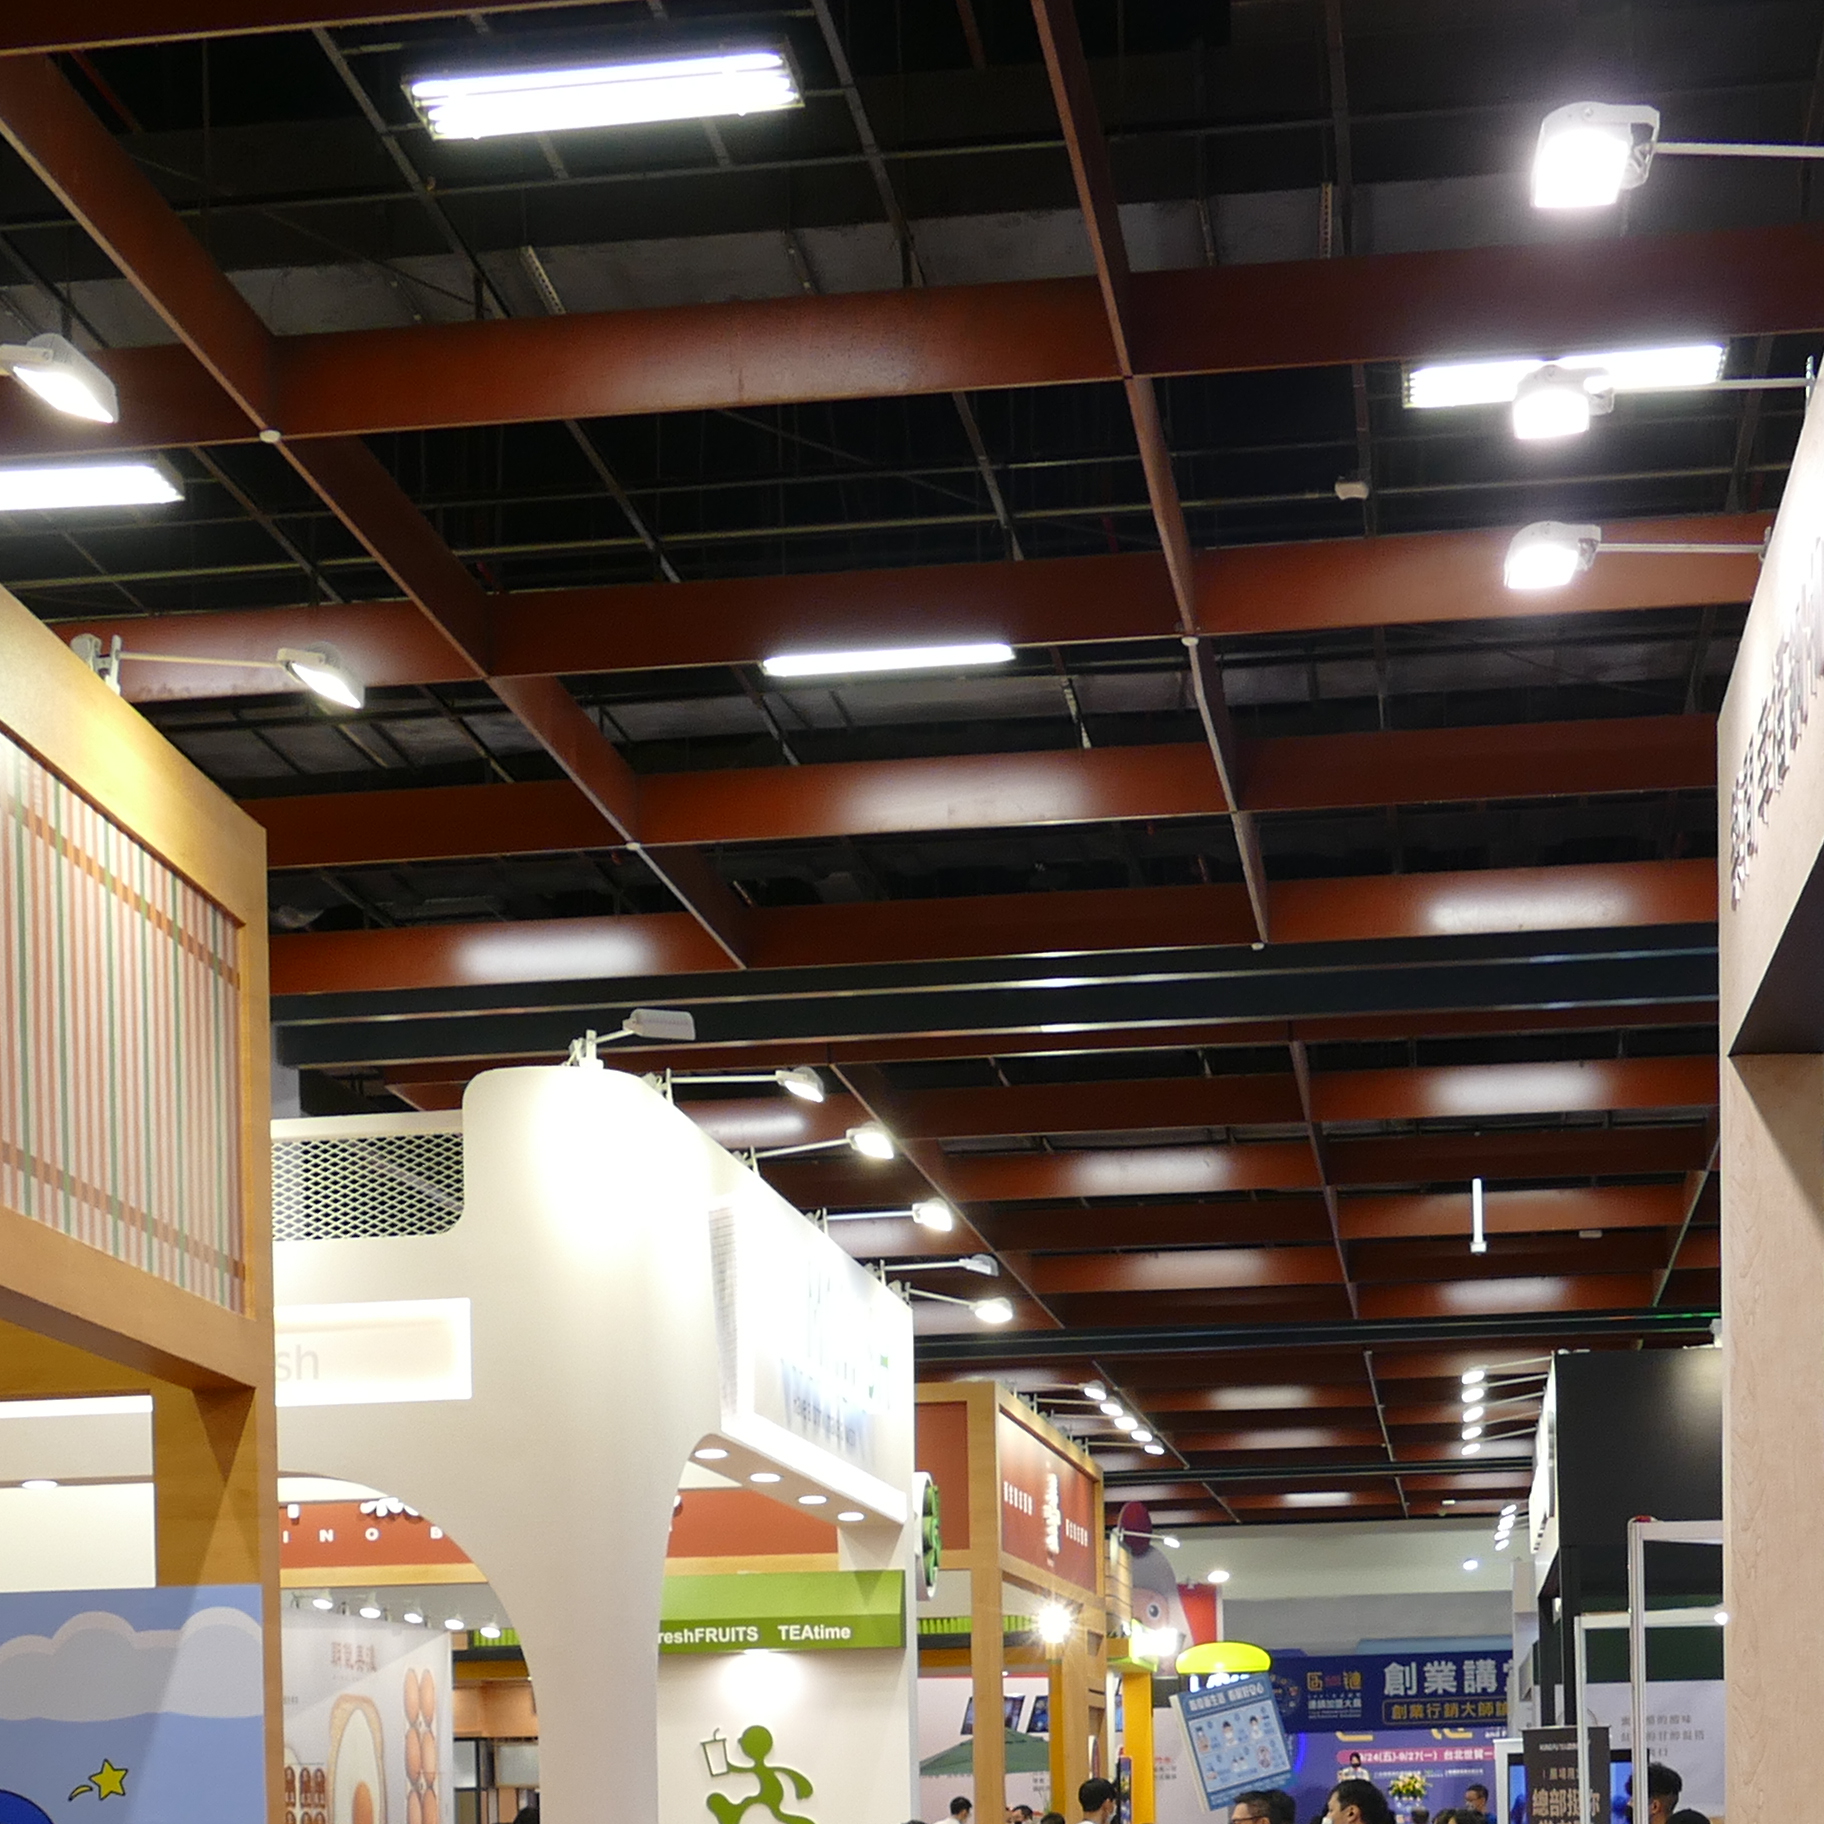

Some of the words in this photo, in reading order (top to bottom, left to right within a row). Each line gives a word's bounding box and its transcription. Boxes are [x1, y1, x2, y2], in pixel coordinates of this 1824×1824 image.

[275, 1344, 320, 1382] sh
[658, 1626, 759, 1644] reshFRUITS
[778, 1624, 851, 1641] TEAtime
[1383, 1658, 1513, 1696] 創業講
